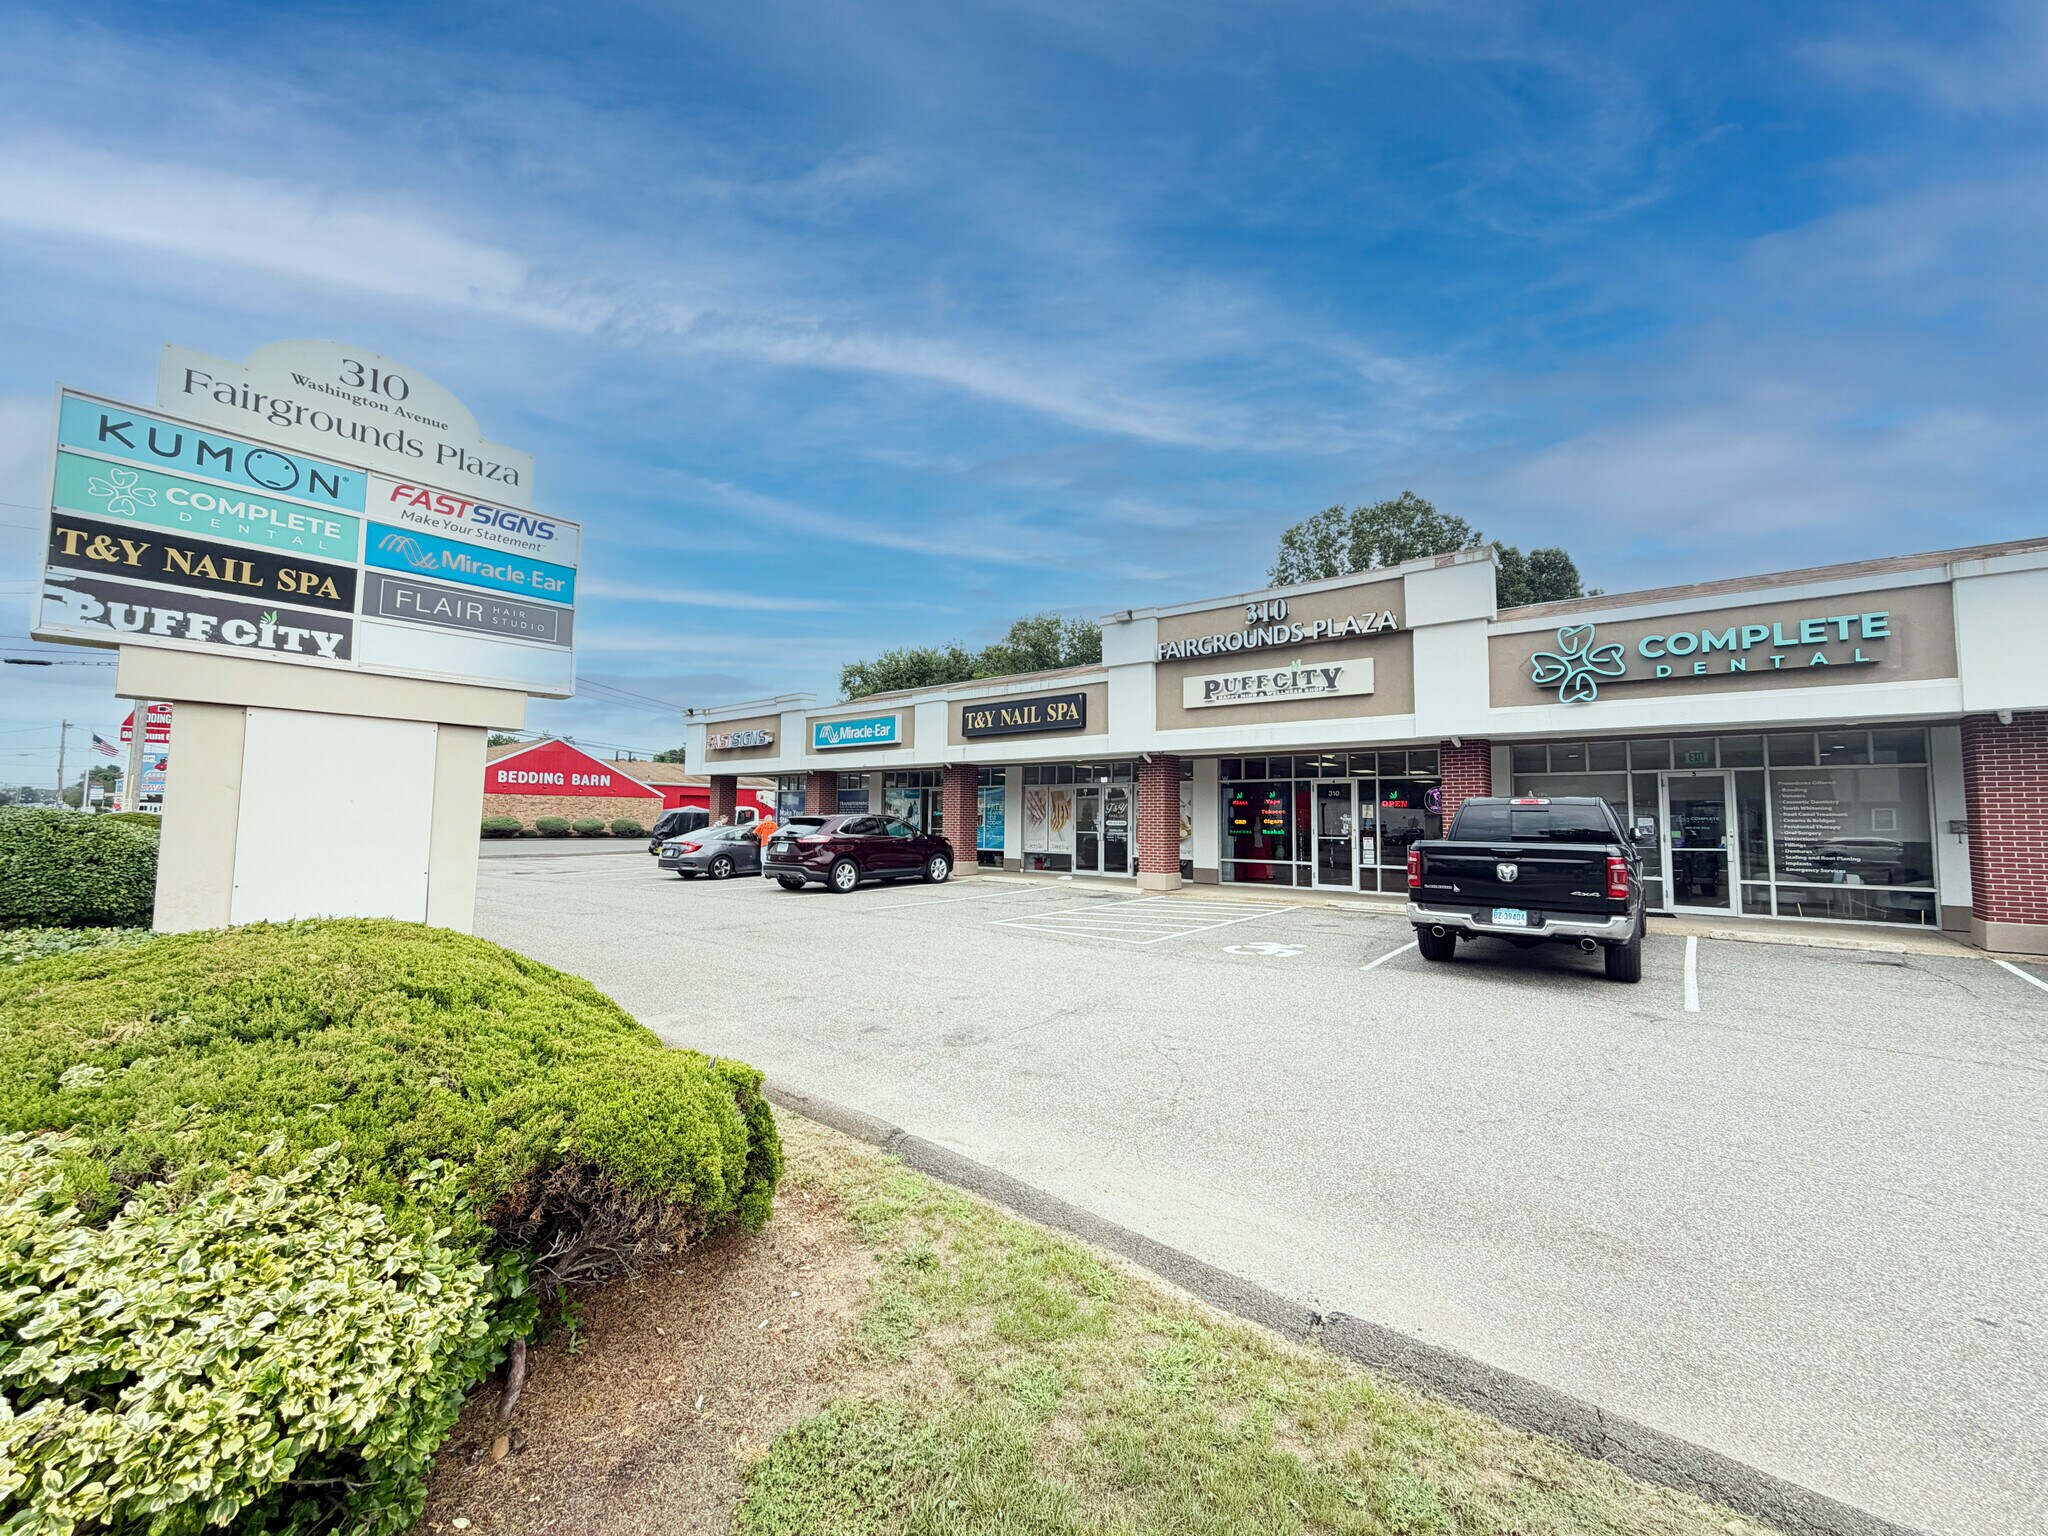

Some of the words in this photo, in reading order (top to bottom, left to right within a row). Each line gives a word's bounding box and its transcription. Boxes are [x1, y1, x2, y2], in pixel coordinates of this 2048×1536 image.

[339, 358, 410, 401] 310
[290, 371, 389, 413] Washington
[393, 405, 449, 431] Avenue
[183, 367, 424, 459] Fairgrounds
[436, 442, 520, 487] Plaza
[166, 487, 342, 539] COMPLETE
[390, 484, 556, 541] FASTSIGNS
[179, 512, 328, 550] DENTAL
[400, 509, 440, 528] Make
[443, 520, 474, 536] Your
[475, 527, 542, 552] Statement
[56, 527, 151, 567] T&Y
[162, 546, 265, 588] NAIL
[277, 567, 341, 600] SPA
[396, 589, 484, 622] FLAIR
[492, 606, 526, 619] HAIR
[1245, 598, 1290, 626] 310
[492, 616, 545, 632] STUDIO
[1157, 622, 1305, 660] FAIRGROUNDS
[1312, 610, 1399, 640] PLAZA
[1638, 610, 1892, 659] COMPLETE
[1656, 648, 1870, 679] DENTAL
[1218, 693, 1240, 701] HAPPY
[1266, 687, 1303, 696] WELLNESS
[1304, 686, 1324, 694] SHOP
[965, 710, 996, 730] T&Y
[1000, 705, 1041, 726] NAIL
[1046, 701, 1080, 722] SPA
[706, 729, 770, 750] FASTSIGNS
[840, 723, 891, 740] Miracle-Ear
[497, 770, 564, 786] BEDDING
[571, 773, 611, 787] BARN
[987, 803, 1004, 811] FREE
[1381, 800, 1408, 808] OPEN
[1570, 890, 1601, 898] 4x4
